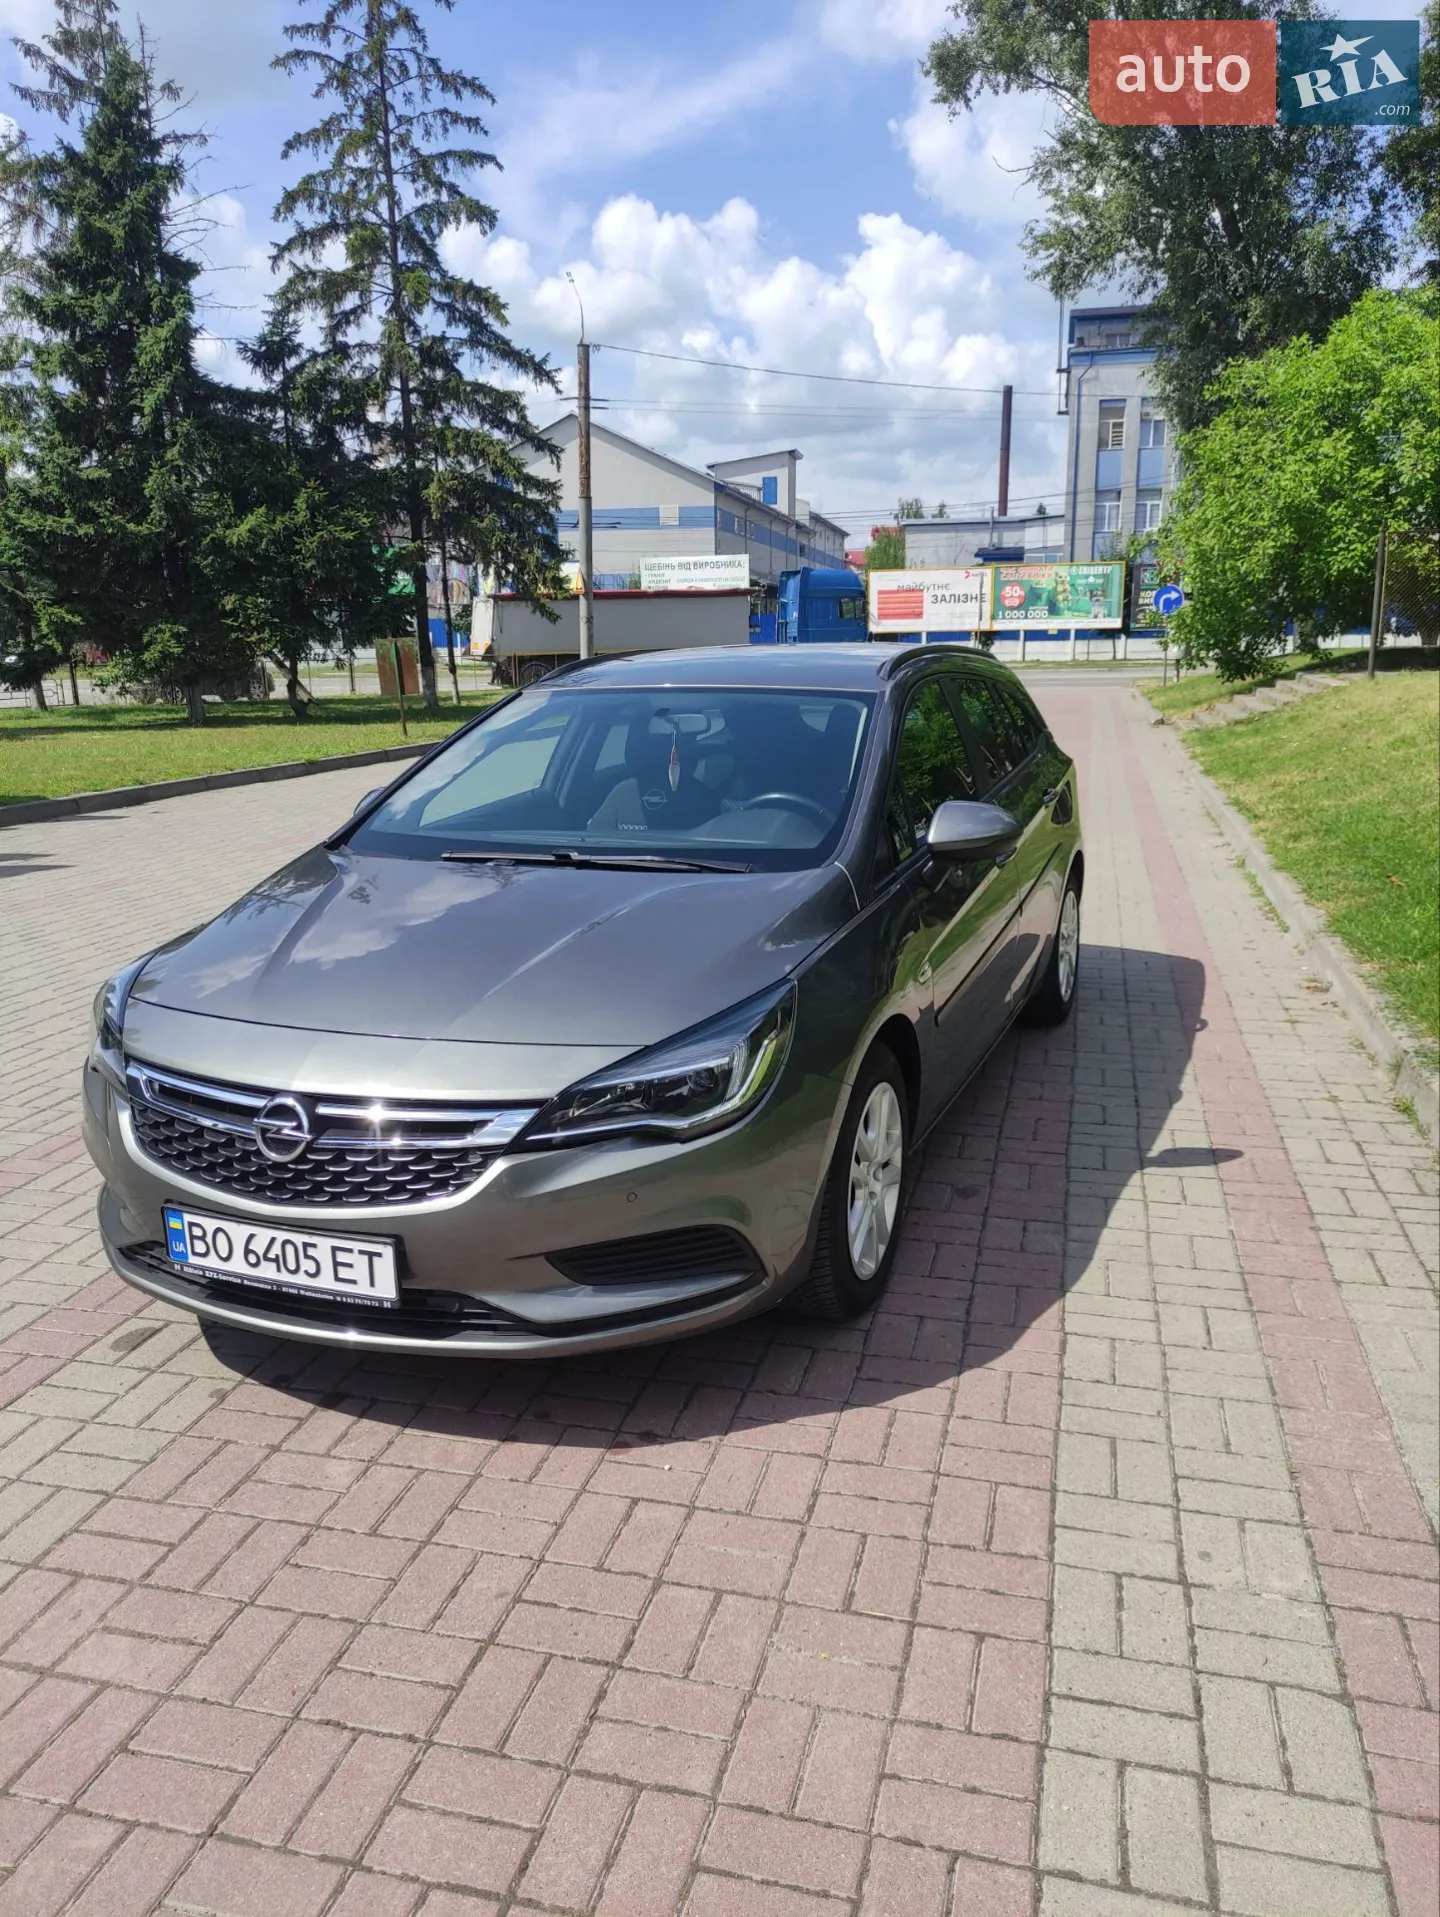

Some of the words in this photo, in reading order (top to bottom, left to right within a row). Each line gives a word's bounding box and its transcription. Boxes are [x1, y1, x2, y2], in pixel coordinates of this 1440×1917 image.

[644, 562, 676, 571] ЩЕБІНЬ
[677, 562, 692, 571] ВІД
[693, 560, 746, 570] ВИРОБНИКА:
[897, 580, 950, 593] майбутнє
[931, 593, 987, 605] ЗАЛІЗНЕ
[172, 1240, 187, 1254] UA
[187, 1220, 234, 1263] BO
[243, 1232, 321, 1279] 6405
[330, 1244, 383, 1288] ET
